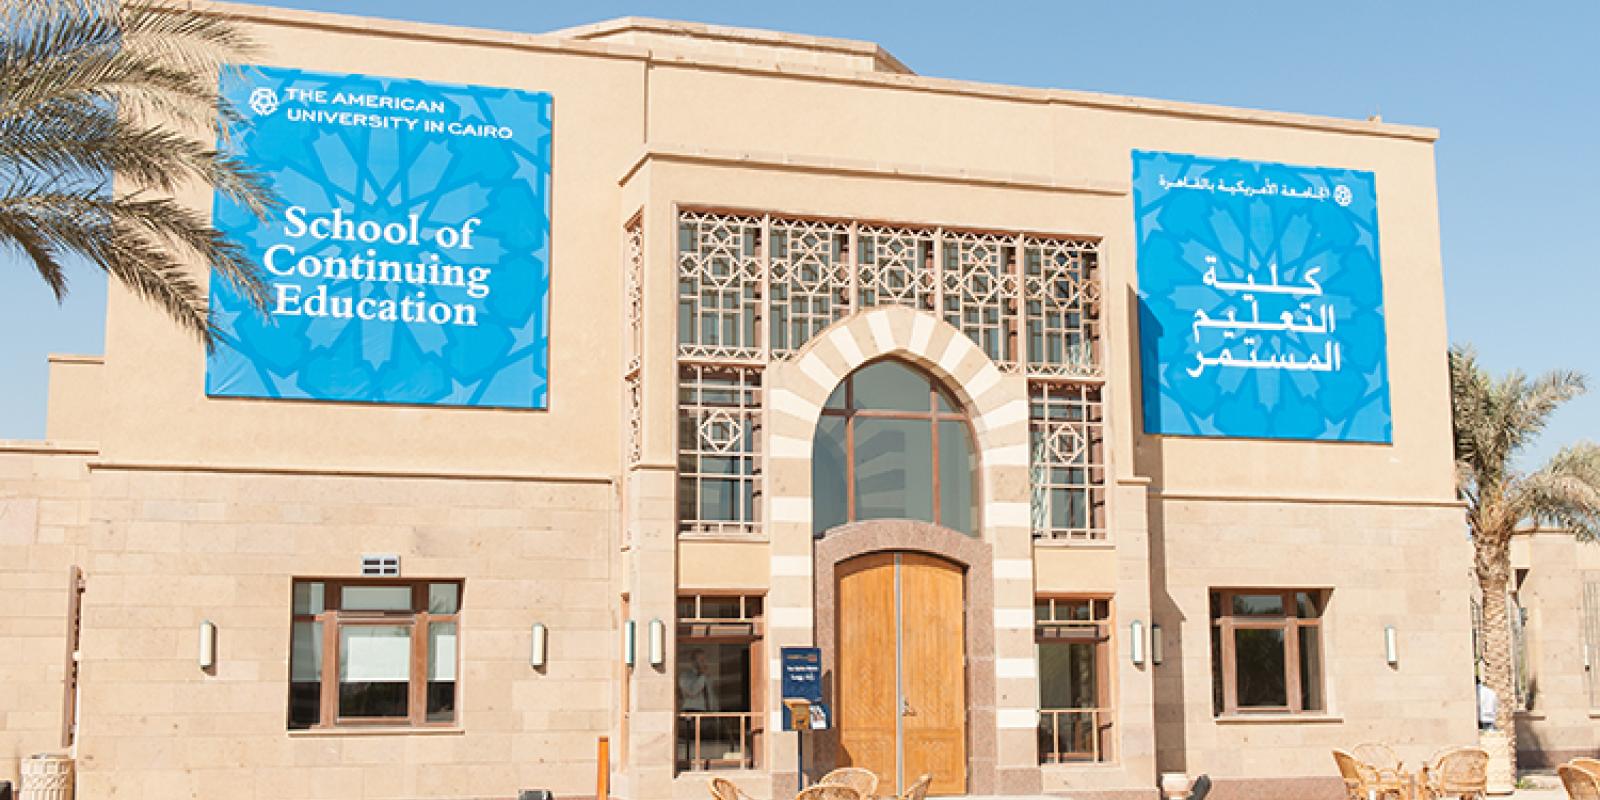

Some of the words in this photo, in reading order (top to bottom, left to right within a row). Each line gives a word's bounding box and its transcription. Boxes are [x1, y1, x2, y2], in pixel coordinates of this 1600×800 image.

[285, 88, 327, 103] THE
[333, 93, 445, 113] AMERICAN
[287, 109, 418, 130] UNIVERSITY
[424, 121, 445, 133] IN
[448, 123, 513, 139] CAIRO
[1160, 175, 1216, 194] بالقاهرة
[1218, 178, 1279, 197] الأمريكية
[1282, 183, 1330, 202] الجامعة
[284, 206, 419, 245] School
[435, 219, 481, 249] of
[264, 244, 491, 297] Continuing
[1202, 256, 1323, 300] كلية
[273, 284, 478, 326] Education
[1193, 298, 1335, 343] التعليم
[1187, 338, 1341, 378] المستمر
